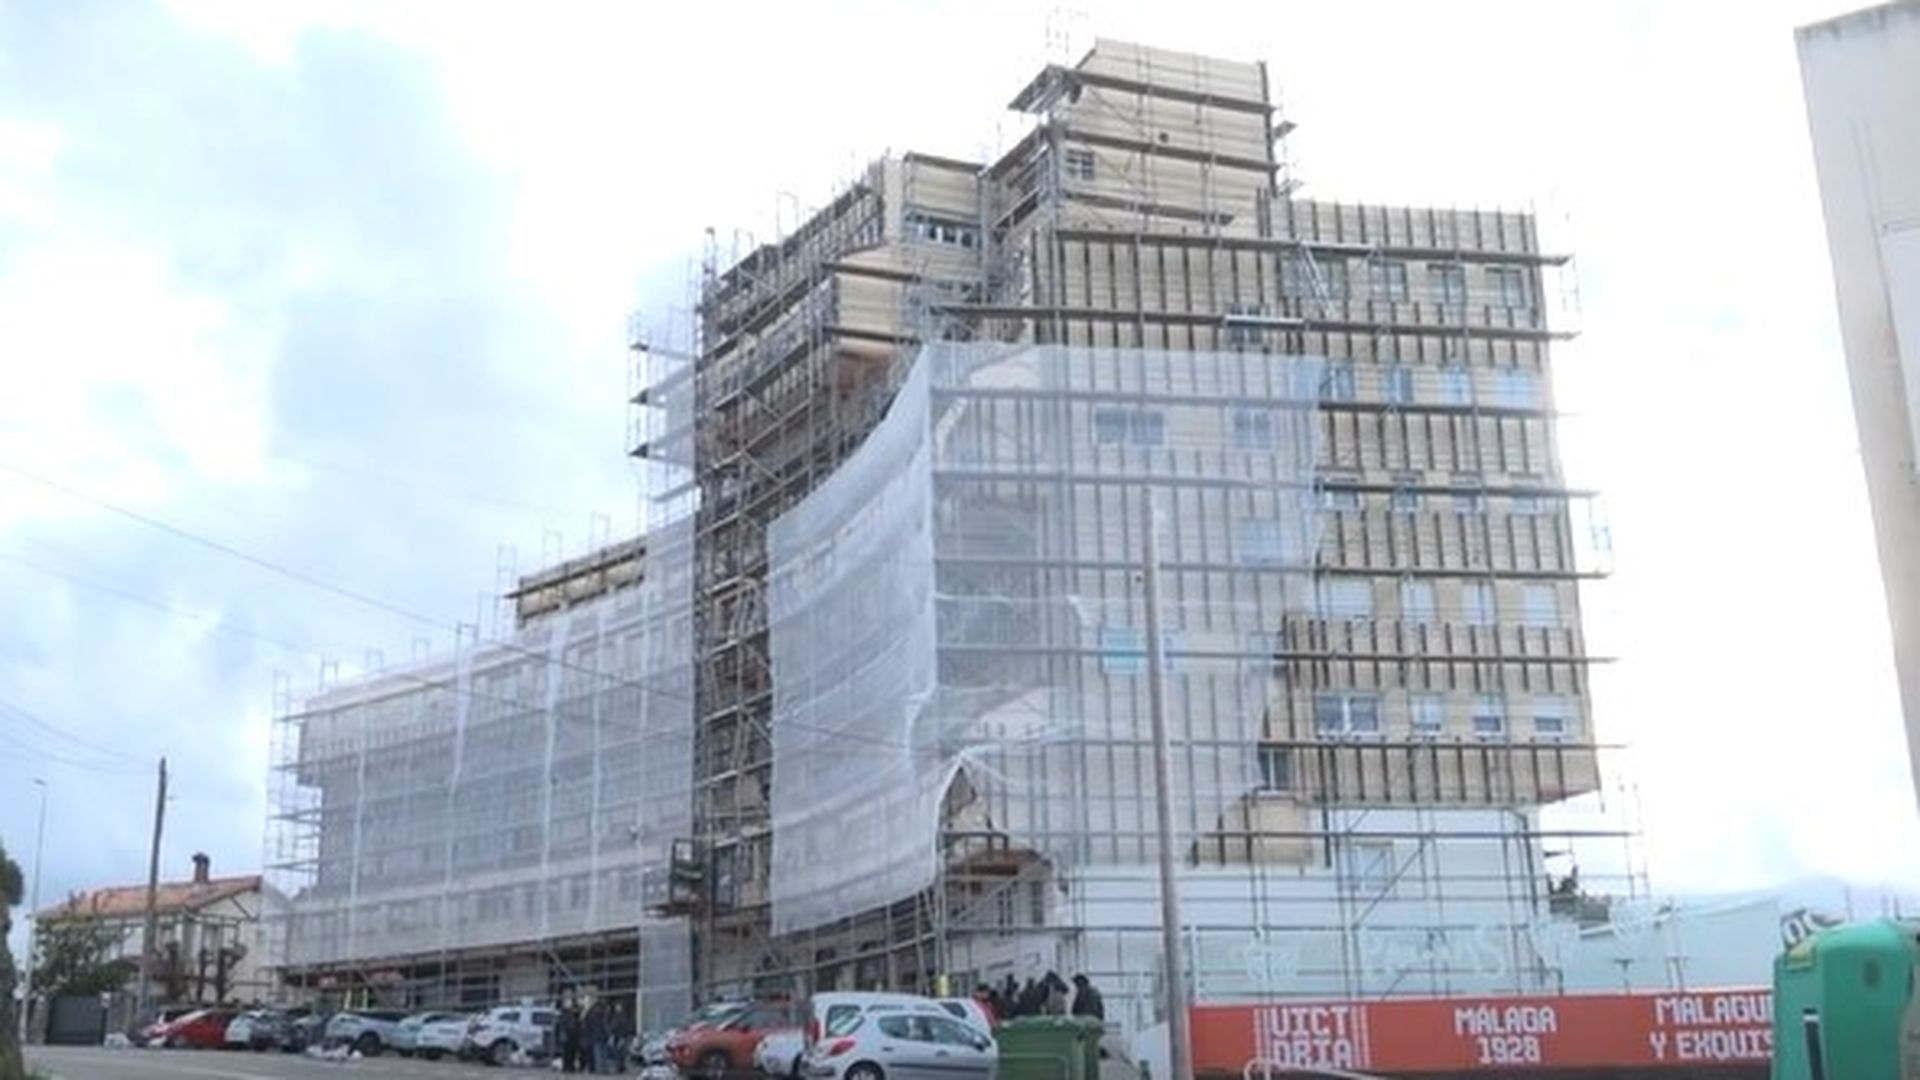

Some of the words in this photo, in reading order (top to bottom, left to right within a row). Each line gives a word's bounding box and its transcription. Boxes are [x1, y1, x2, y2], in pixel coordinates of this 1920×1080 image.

[1455, 1003, 1556, 1035] MÁLAGA
[1478, 1036, 1541, 1064] 1928
[1650, 1031, 1666, 1060] Y
